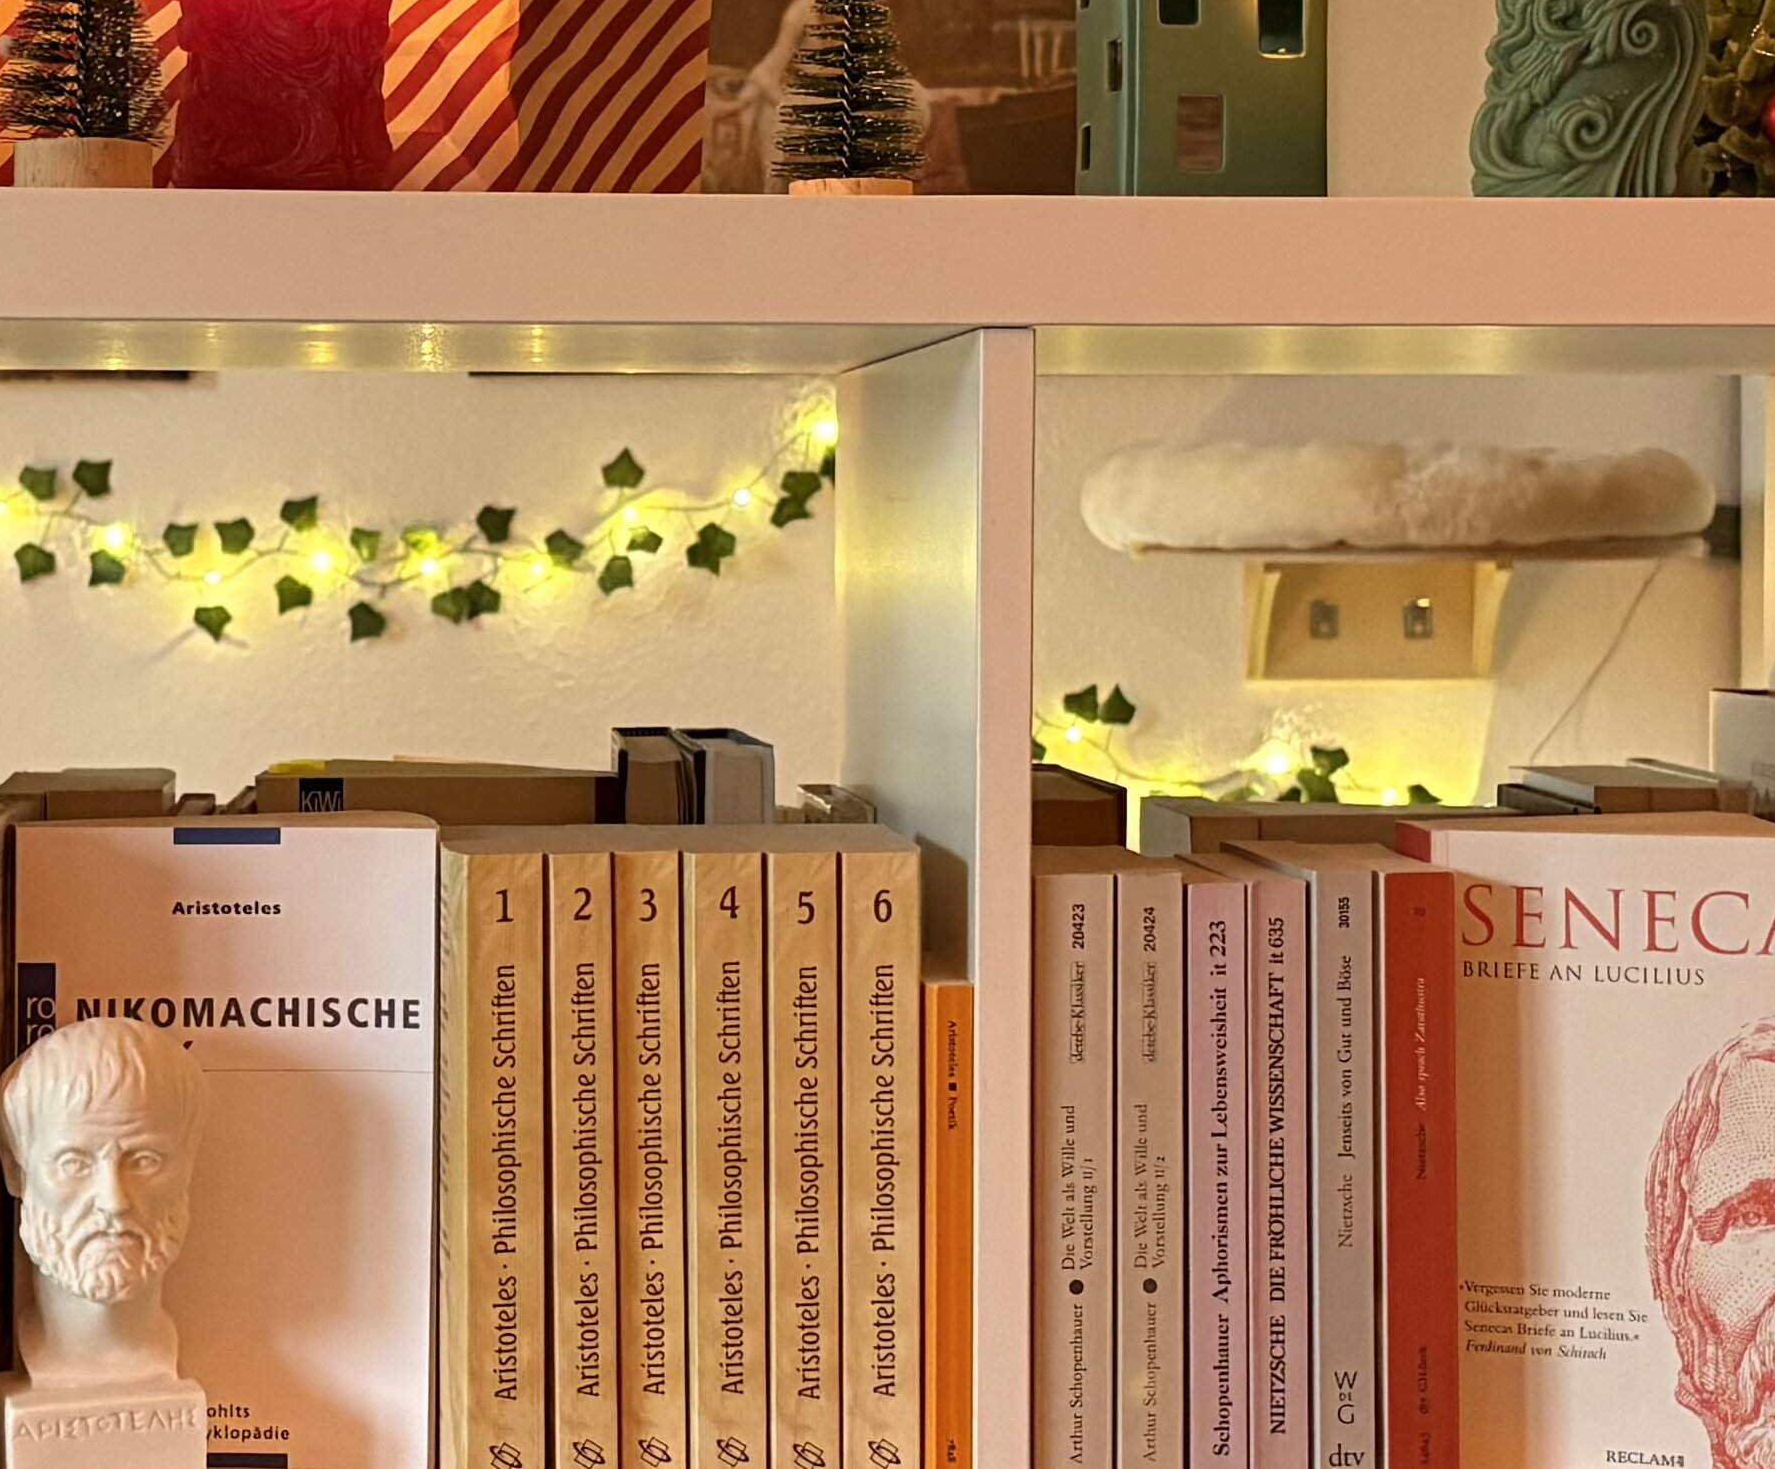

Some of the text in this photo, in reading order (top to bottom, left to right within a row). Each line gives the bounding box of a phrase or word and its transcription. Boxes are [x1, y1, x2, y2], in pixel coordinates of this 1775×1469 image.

[172, 900, 282, 916] Aristoteles
[495, 890, 514, 924] 1
[573, 887, 593, 921] 2
[639, 888, 658, 923] 3
[719, 885, 740, 919] 4
[797, 890, 815, 925] 5
[873, 890, 892, 923] 6
[1338, 896, 1351, 928] 30155
[1462, 961, 1706, 987] BRIEFE AN LUCILIUS
[76, 997, 421, 1029] NIKOMACHISCHE
[1337, 954, 1356, 1248] Nietzsche Jenseits von Gut und Böse
[493, 963, 523, 1402] Aristoteles Philosophische Schriften
[572, 962, 603, 1398] Aristoteles Philosophische Schriften
[717, 960, 748, 1396] Aristoteles Philosophische Schriften
[870, 963, 901, 1398] Aristoteles Philosophische Schriften
[1059, 1105, 1076, 1270] Die Welt als Wille und
[1209, 920, 1231, 1456] Schopenhauer Aphorismen zur Lebensweisheit it 223
[1266, 917, 1287, 1435] NIETZSCHE DIE FRÖHLICHE WISSENSCHAFT it 635
[1564, 1307, 1589, 1320] und
[1628, 1310, 1648, 1323] Sie
[1069, 1304, 1087, 1464] Arthur Schopenhauer
[1328, 1443, 1365, 1468] dtv
[1606, 1449, 1677, 1467] RECLAM
